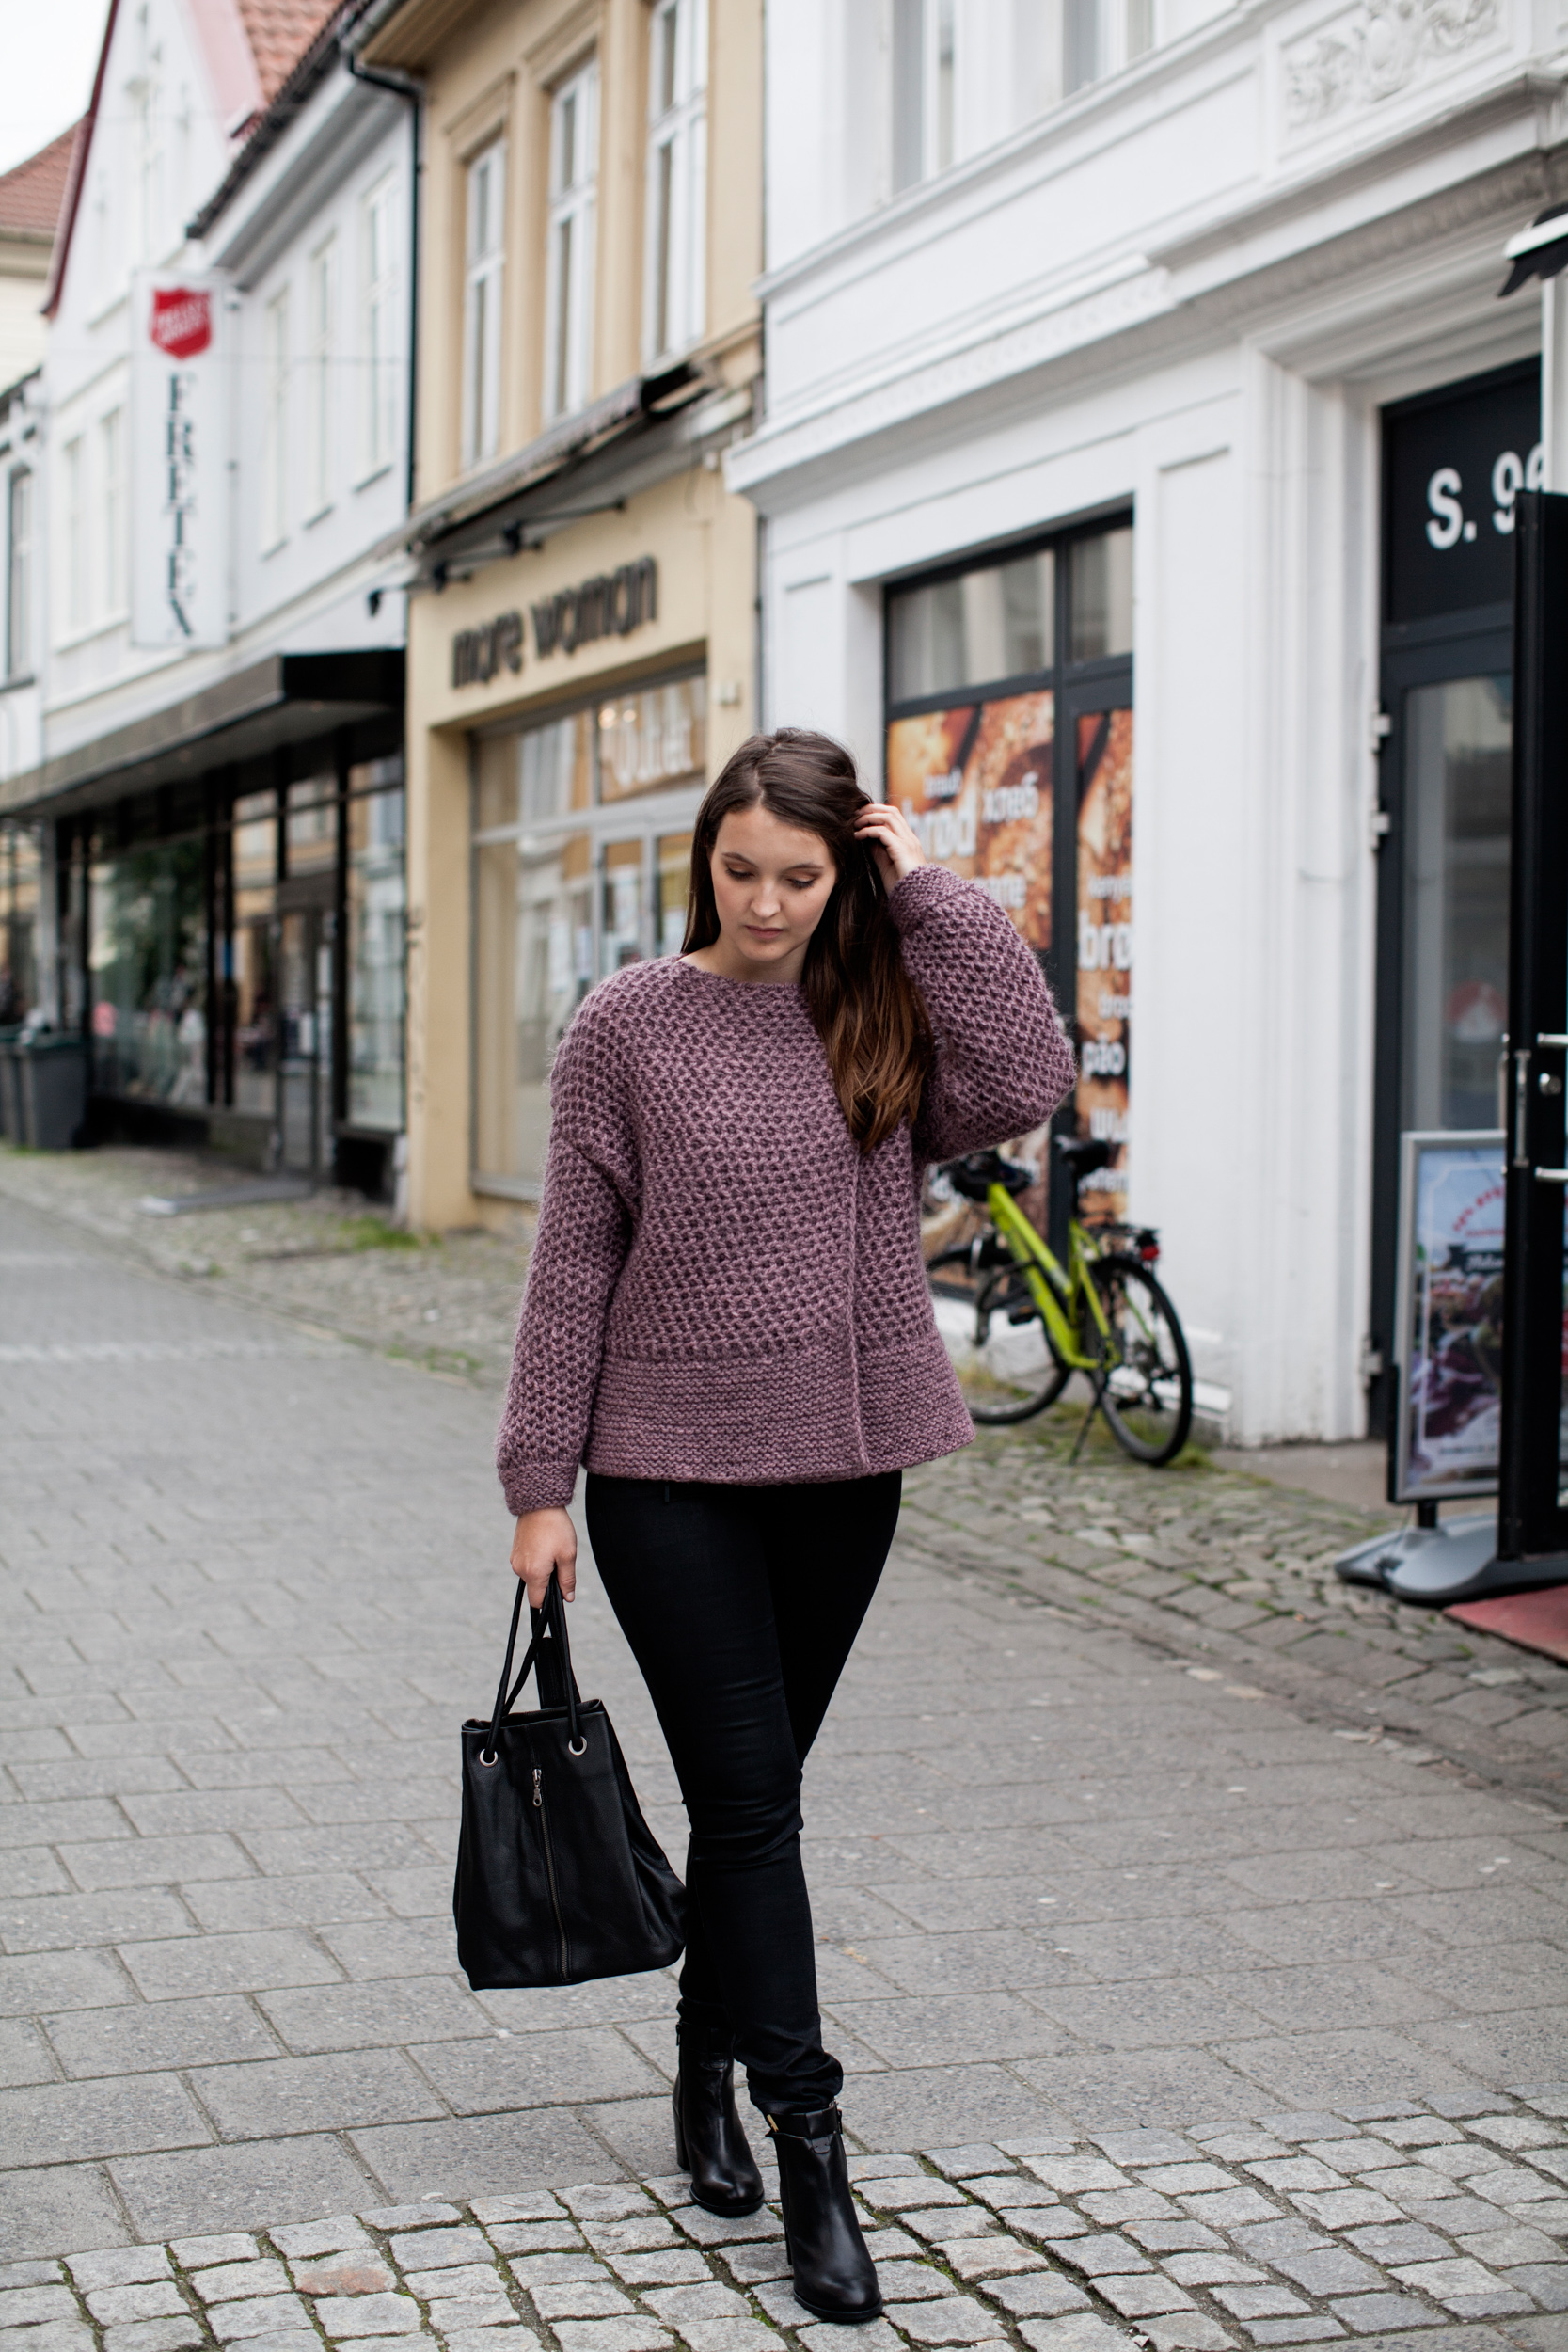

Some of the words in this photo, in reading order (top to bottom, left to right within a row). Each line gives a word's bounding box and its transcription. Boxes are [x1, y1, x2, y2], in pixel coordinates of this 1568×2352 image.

[163, 372, 198, 639] FRETEX
[1425, 467, 1477, 550] S.
[529, 551, 658, 660] woman
